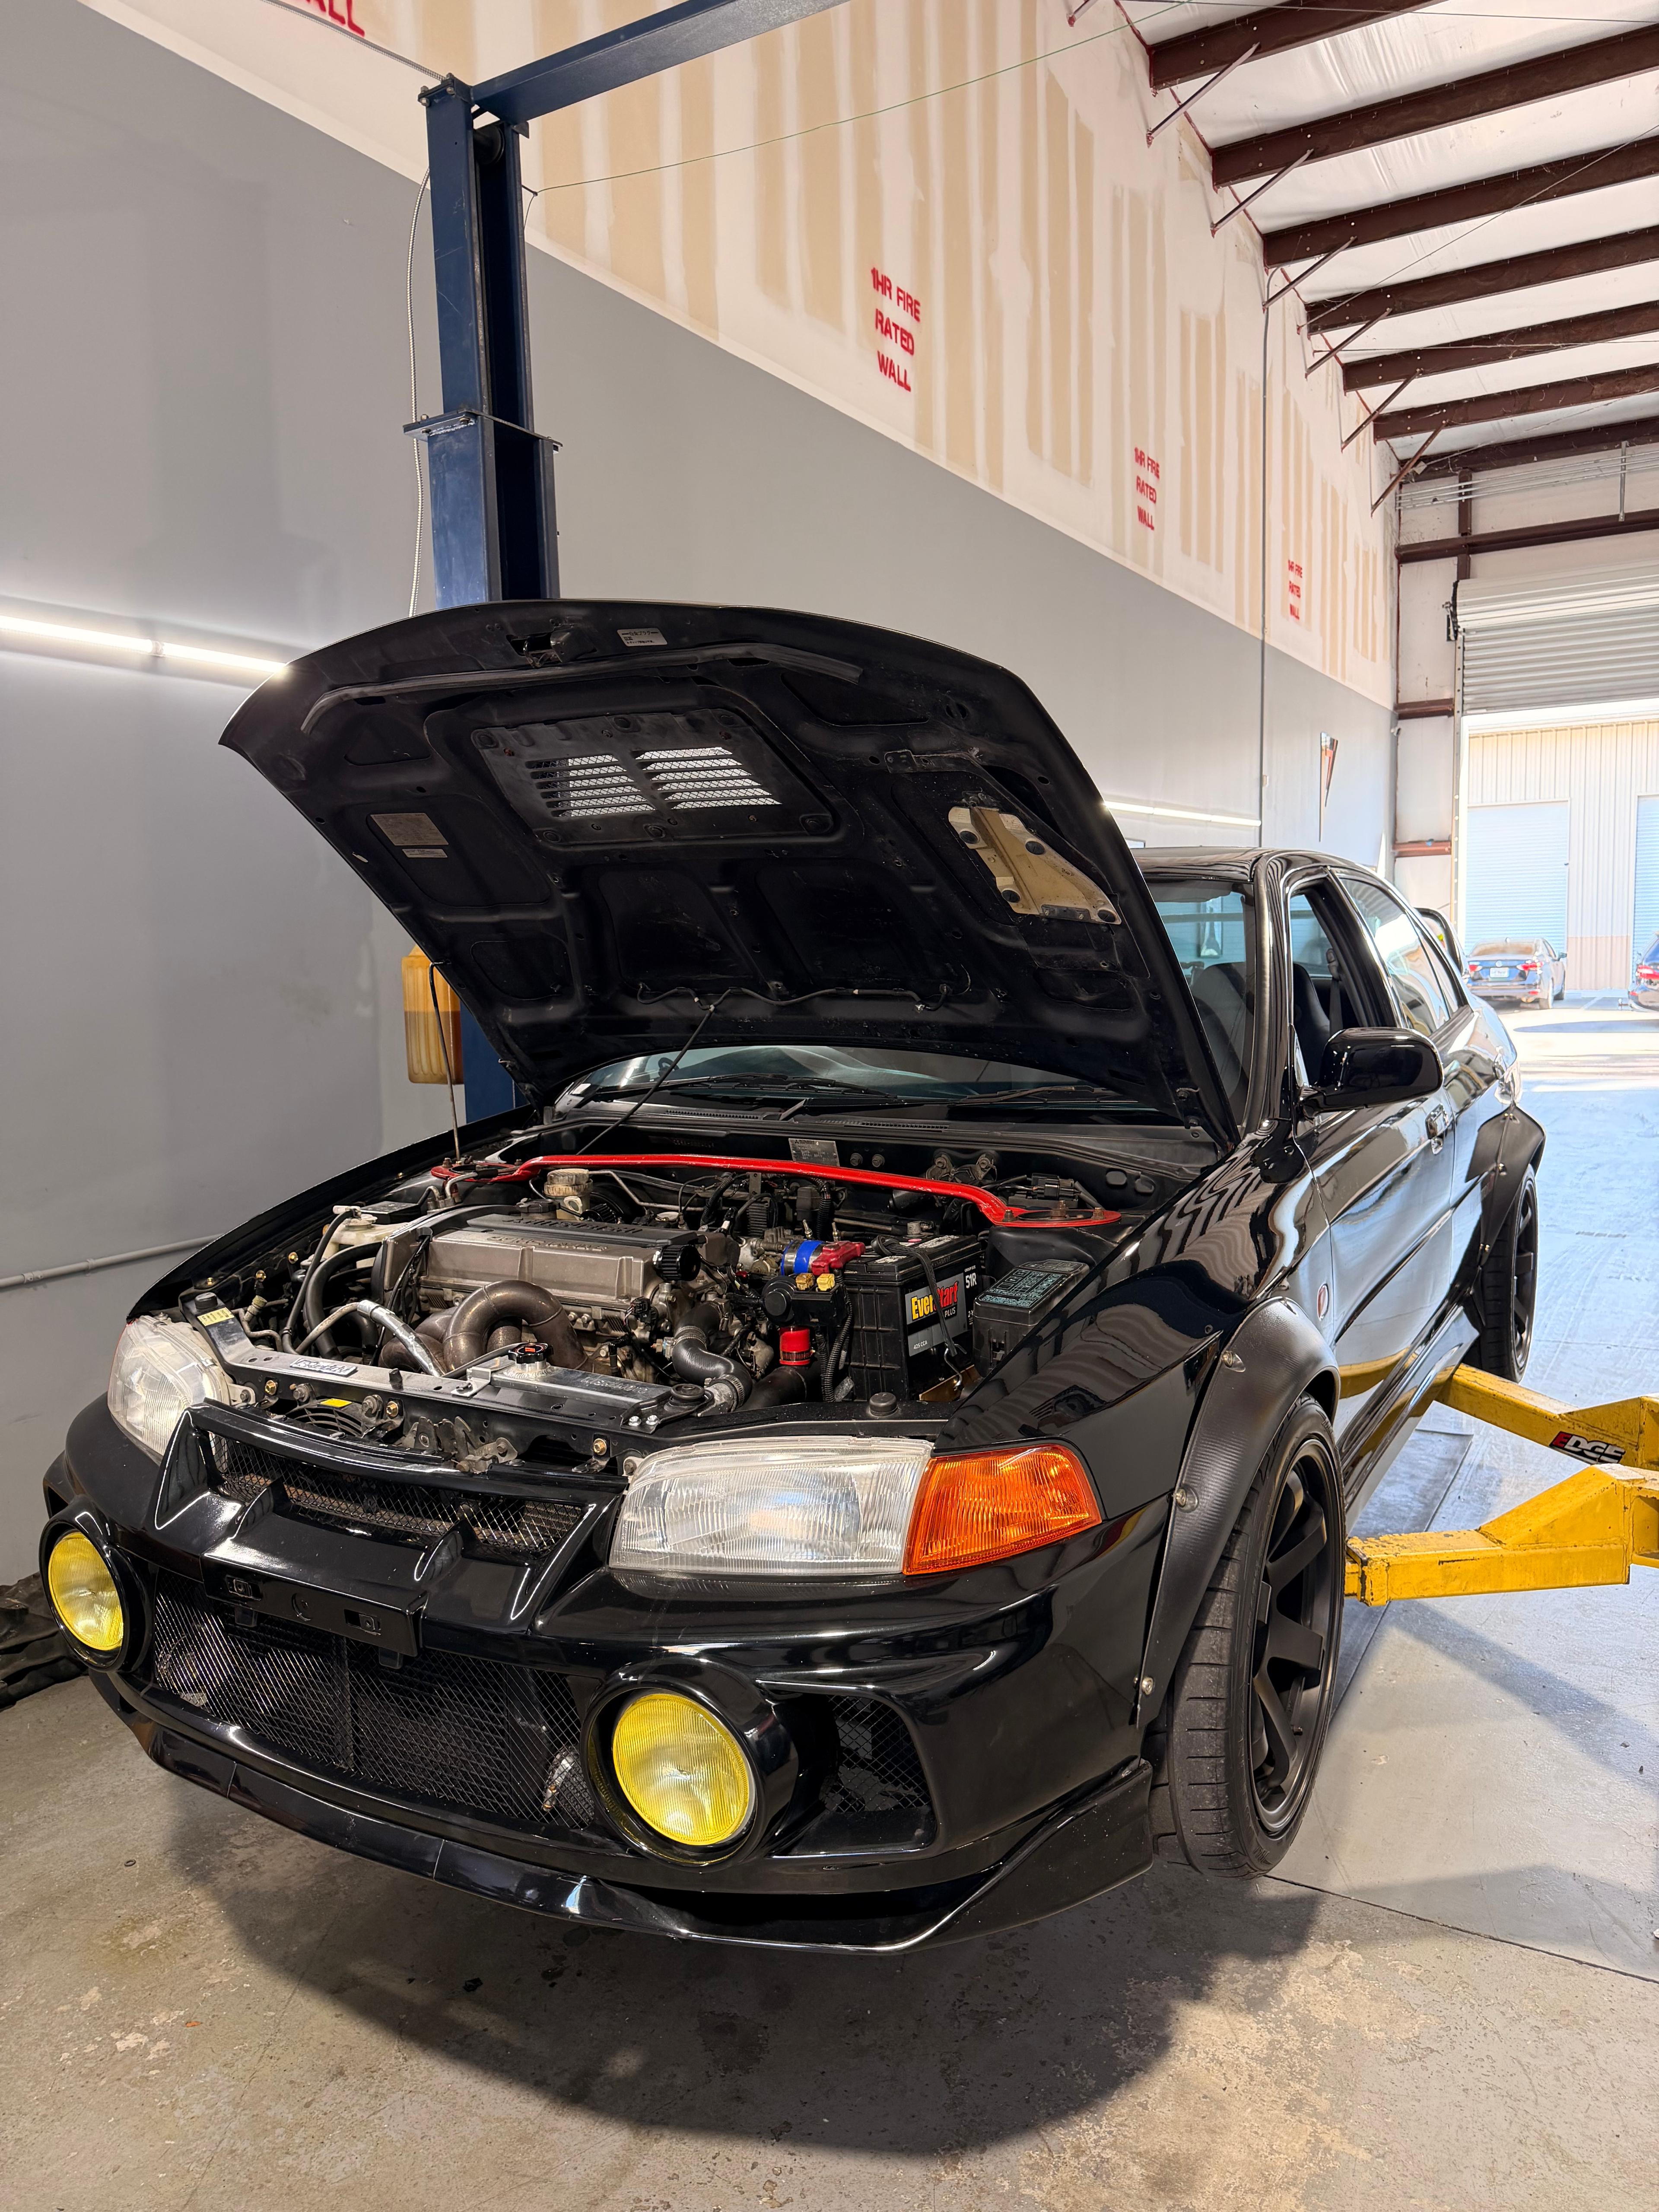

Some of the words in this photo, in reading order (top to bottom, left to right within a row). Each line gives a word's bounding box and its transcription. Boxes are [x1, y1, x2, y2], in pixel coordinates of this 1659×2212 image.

[870, 267, 892, 300] 1HR
[896, 286, 921, 323] FIRE
[874, 308, 914, 356] RATED
[877, 350, 911, 392] WALL
[1147, 456, 1160, 480] FIRE
[1136, 476, 1156, 504] RATED
[1137, 505, 1154, 531] WALL
[966, 1272, 977, 1289] 51R
[911, 1281, 958, 1320] Evertart
[944, 1306, 956, 1318] PLUS
[1551, 1432, 1626, 1463] EDGE
